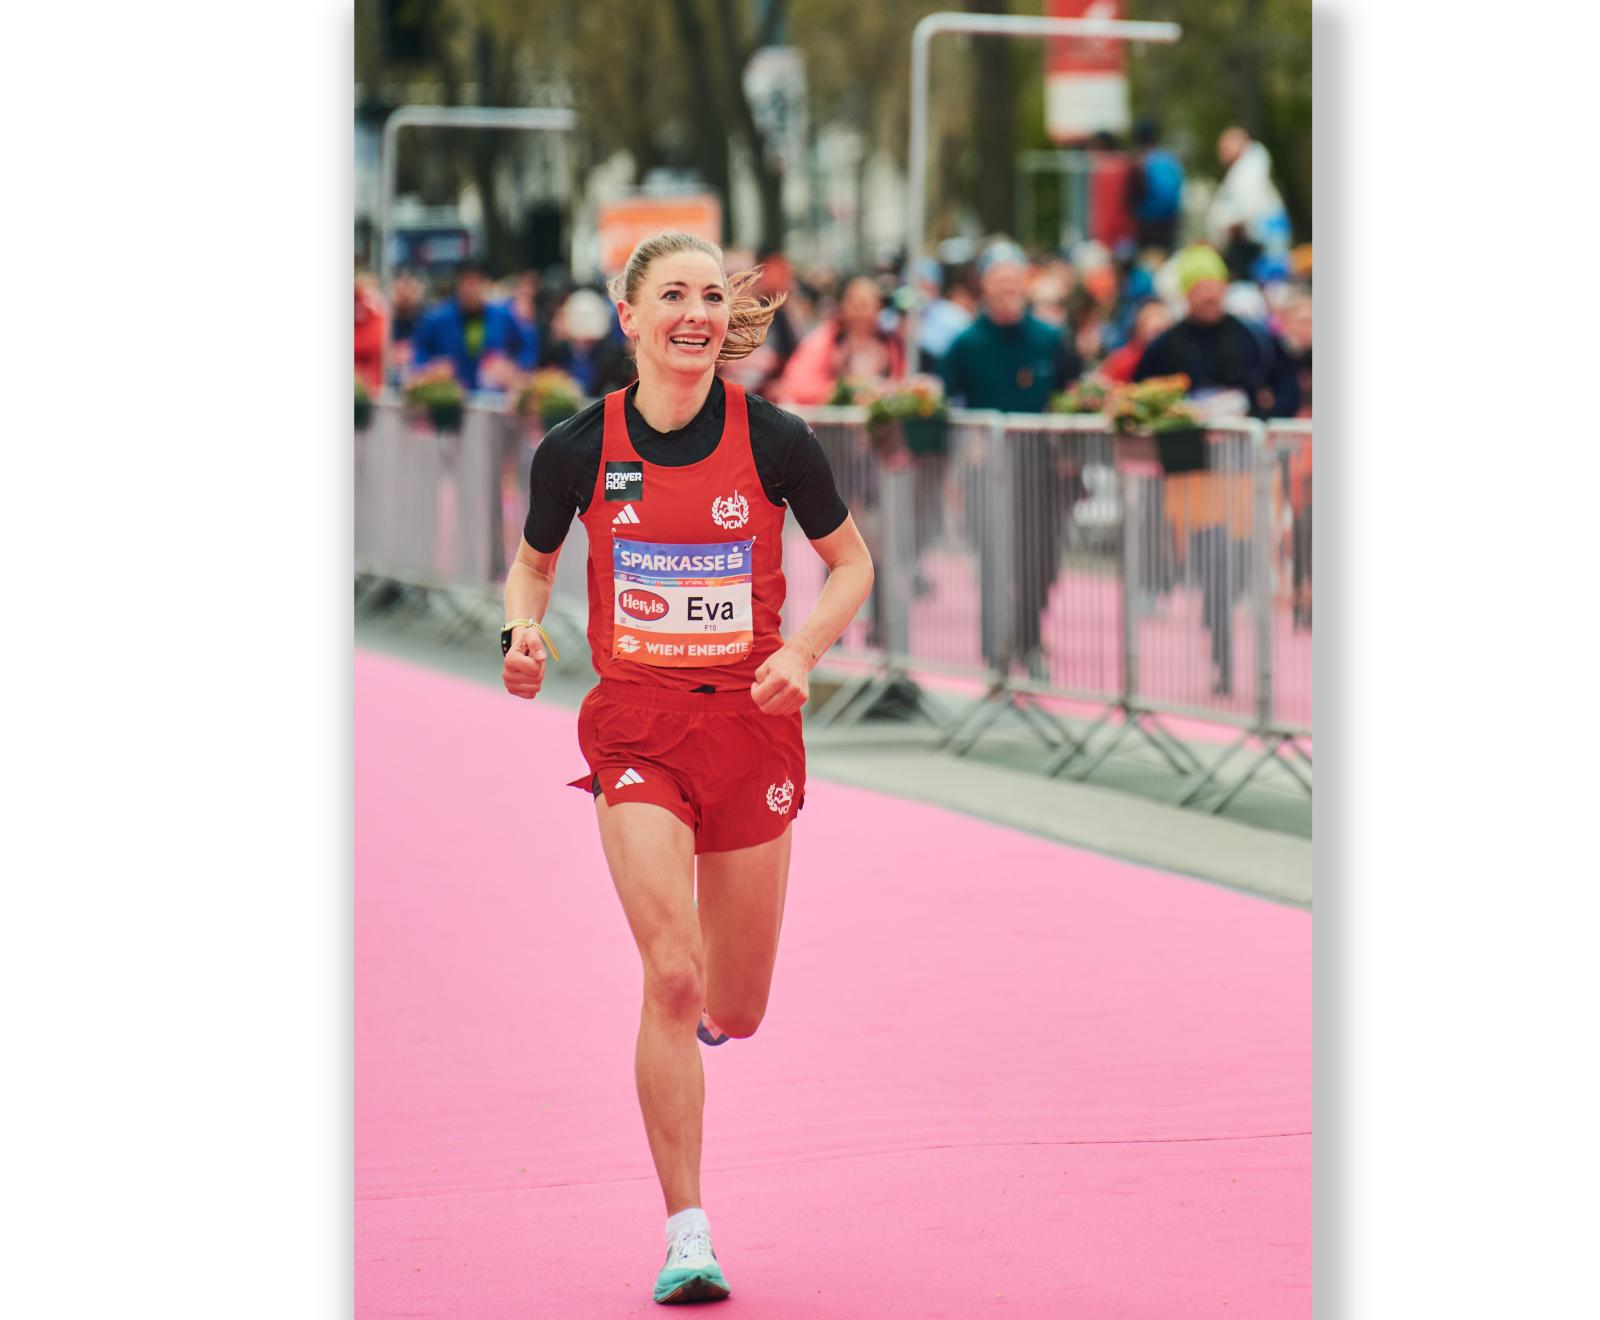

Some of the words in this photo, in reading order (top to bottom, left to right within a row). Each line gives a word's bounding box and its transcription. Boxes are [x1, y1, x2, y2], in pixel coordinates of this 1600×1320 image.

[605, 472, 642, 482] POWER
[605, 481, 627, 490] ADE
[722, 520, 743, 530] VCM
[620, 550, 725, 572] SPARKASSE
[622, 592, 665, 616] Hervis
[687, 596, 734, 621] Eva
[645, 641, 684, 657] WIEN
[687, 641, 749, 657] ENERGIE
